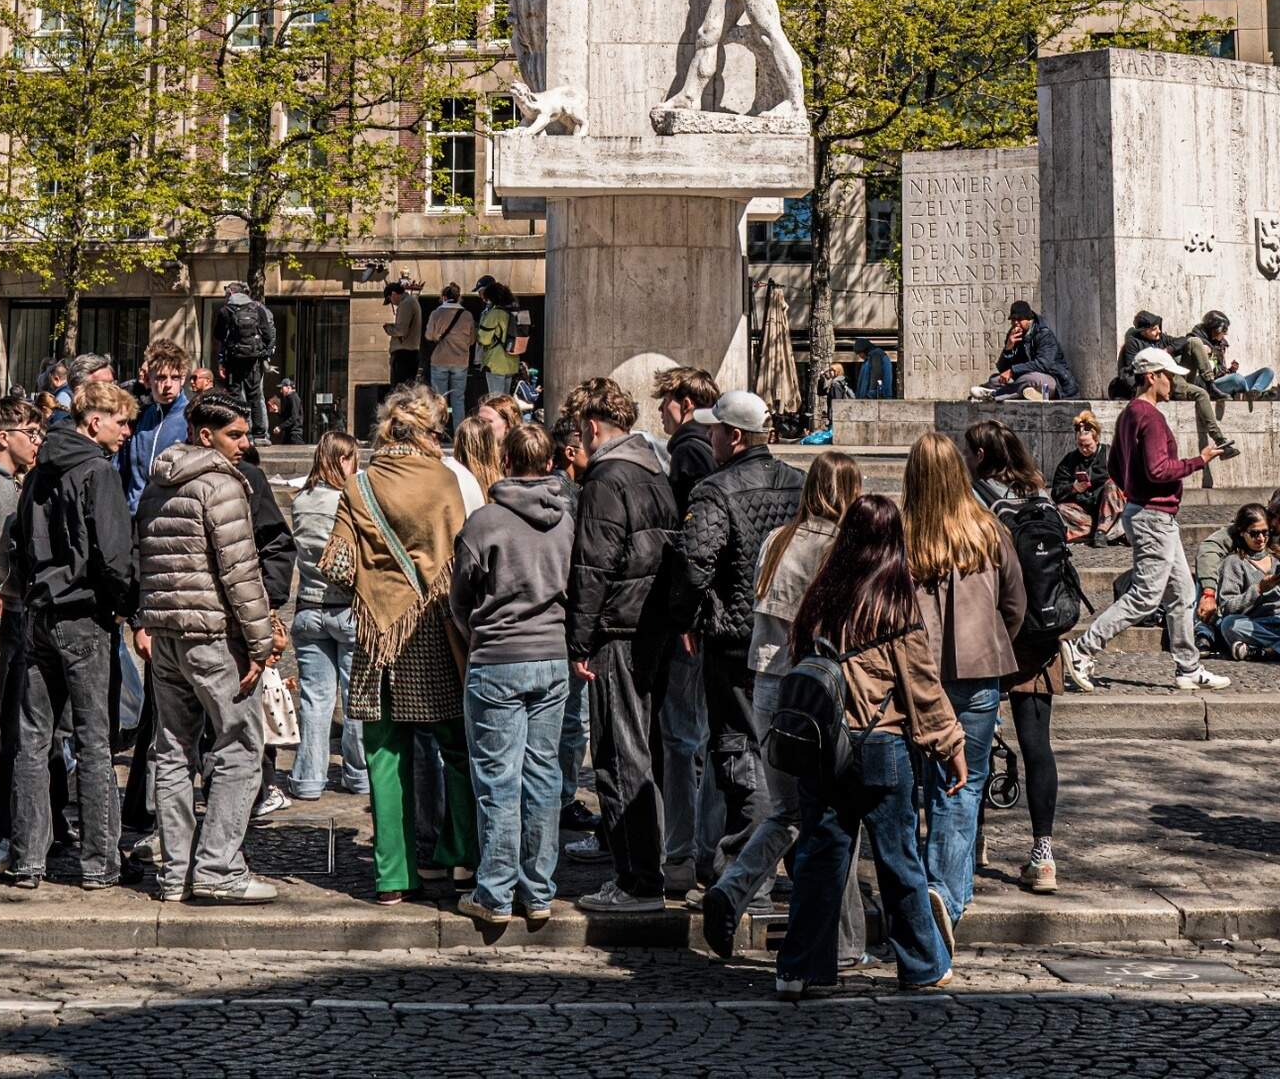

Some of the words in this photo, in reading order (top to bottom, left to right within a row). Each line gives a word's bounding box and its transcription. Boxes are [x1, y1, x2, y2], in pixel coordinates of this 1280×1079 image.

[911, 222, 938, 239] DE
[911, 241, 1022, 261] DEINSDEN
[911, 263, 1023, 282] ELKANDER
[911, 287, 994, 305] WERELD
[911, 309, 968, 327] GEEN
[912, 332, 942, 353] WIJ
[912, 355, 980, 372] ENKEL
